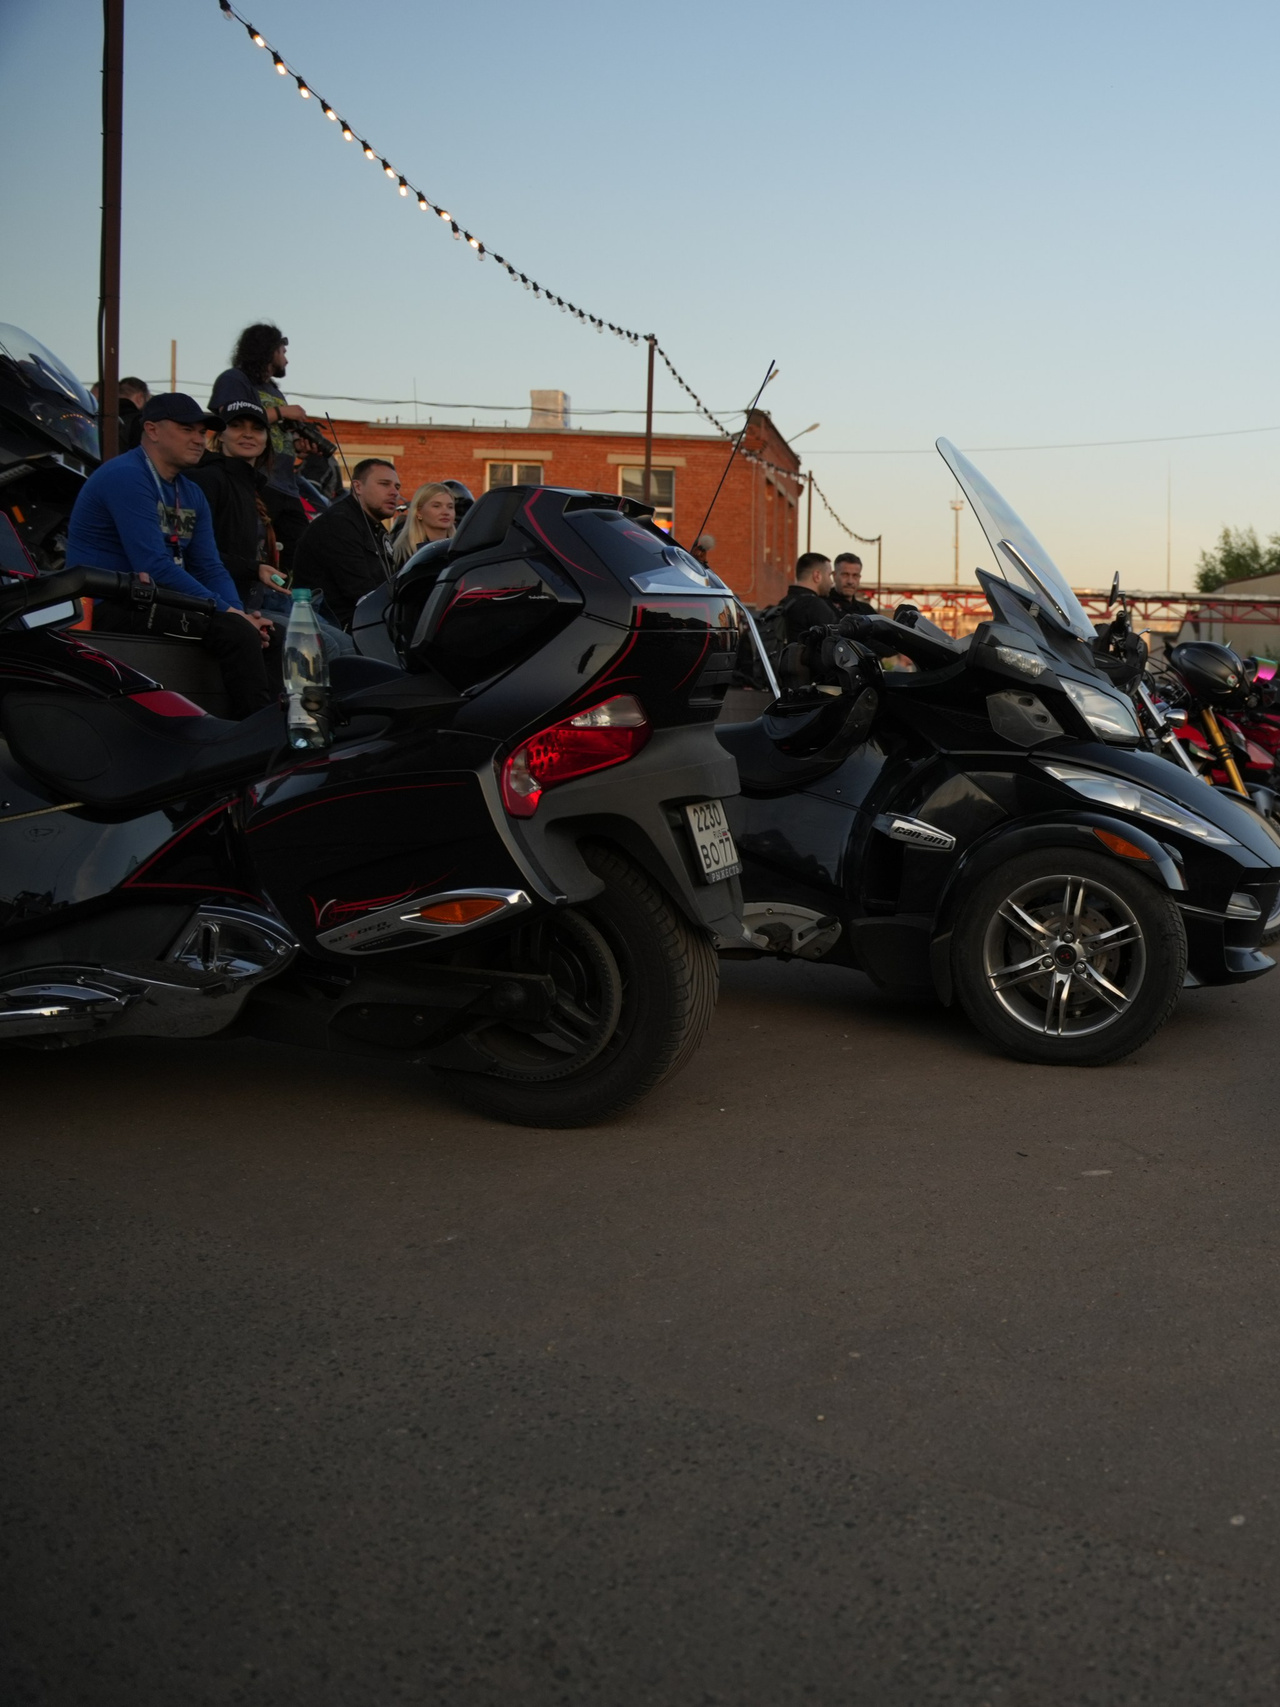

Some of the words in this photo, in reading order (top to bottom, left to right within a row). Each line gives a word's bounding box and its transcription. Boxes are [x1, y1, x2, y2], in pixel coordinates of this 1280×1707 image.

[693, 803, 722, 832] 2230
[894, 826, 948, 846] can-am
[719, 837, 734, 863] 77
